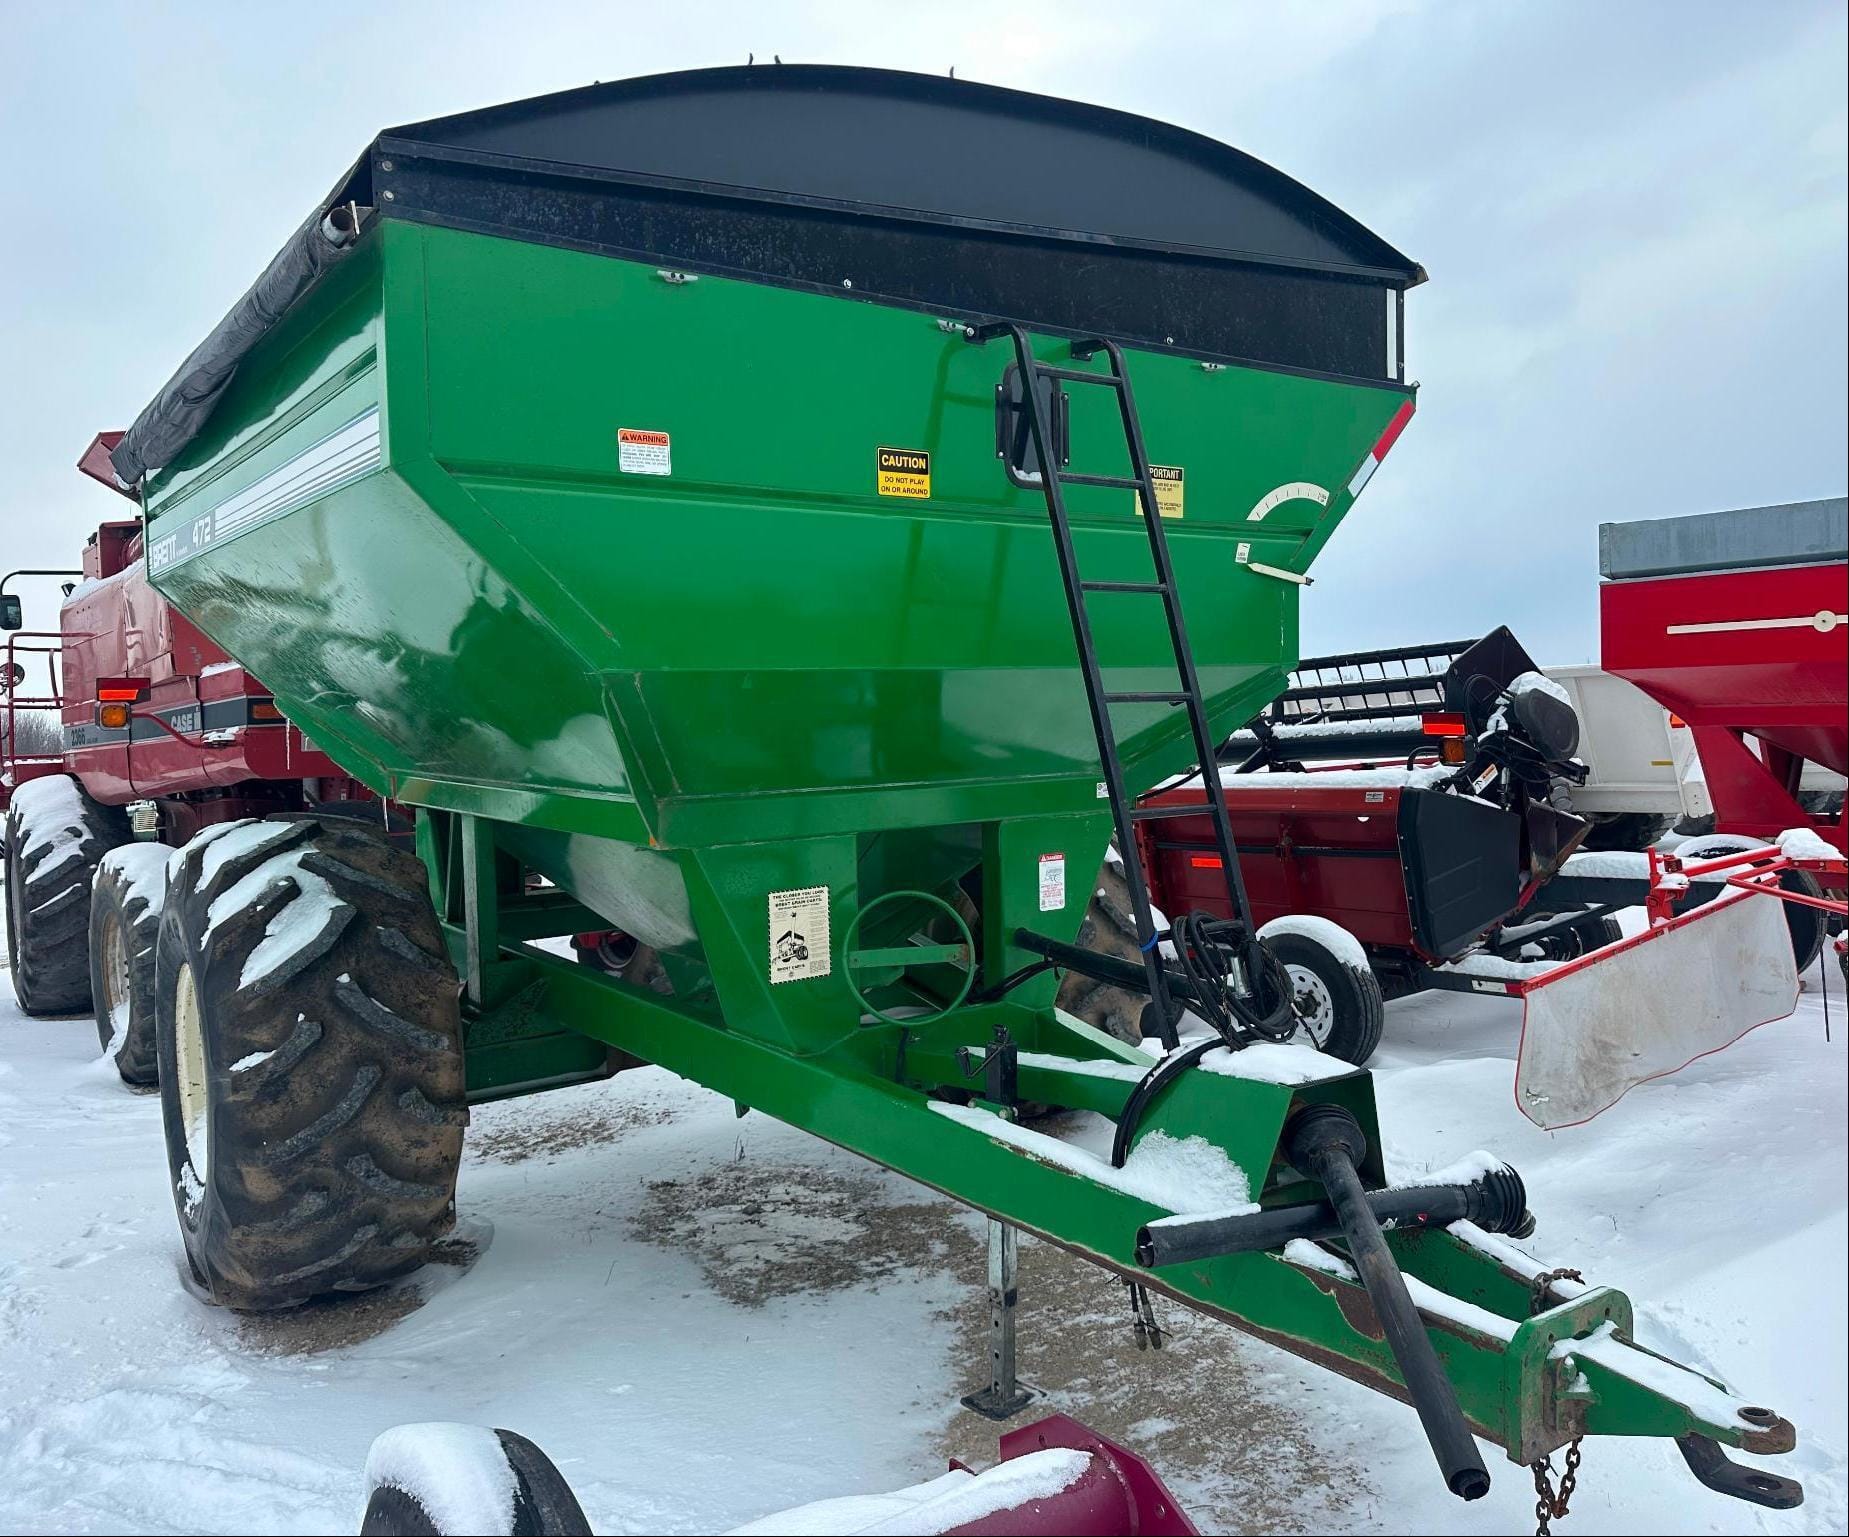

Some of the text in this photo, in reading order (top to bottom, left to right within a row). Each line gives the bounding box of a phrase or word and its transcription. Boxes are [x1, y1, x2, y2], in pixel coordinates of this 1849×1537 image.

[630, 433, 667, 443] WARNING
[881, 454, 926, 469] CAUTION
[1149, 467, 1180, 480] PORTANT
[192, 516, 211, 548] 472
[171, 713, 193, 732] CASE
